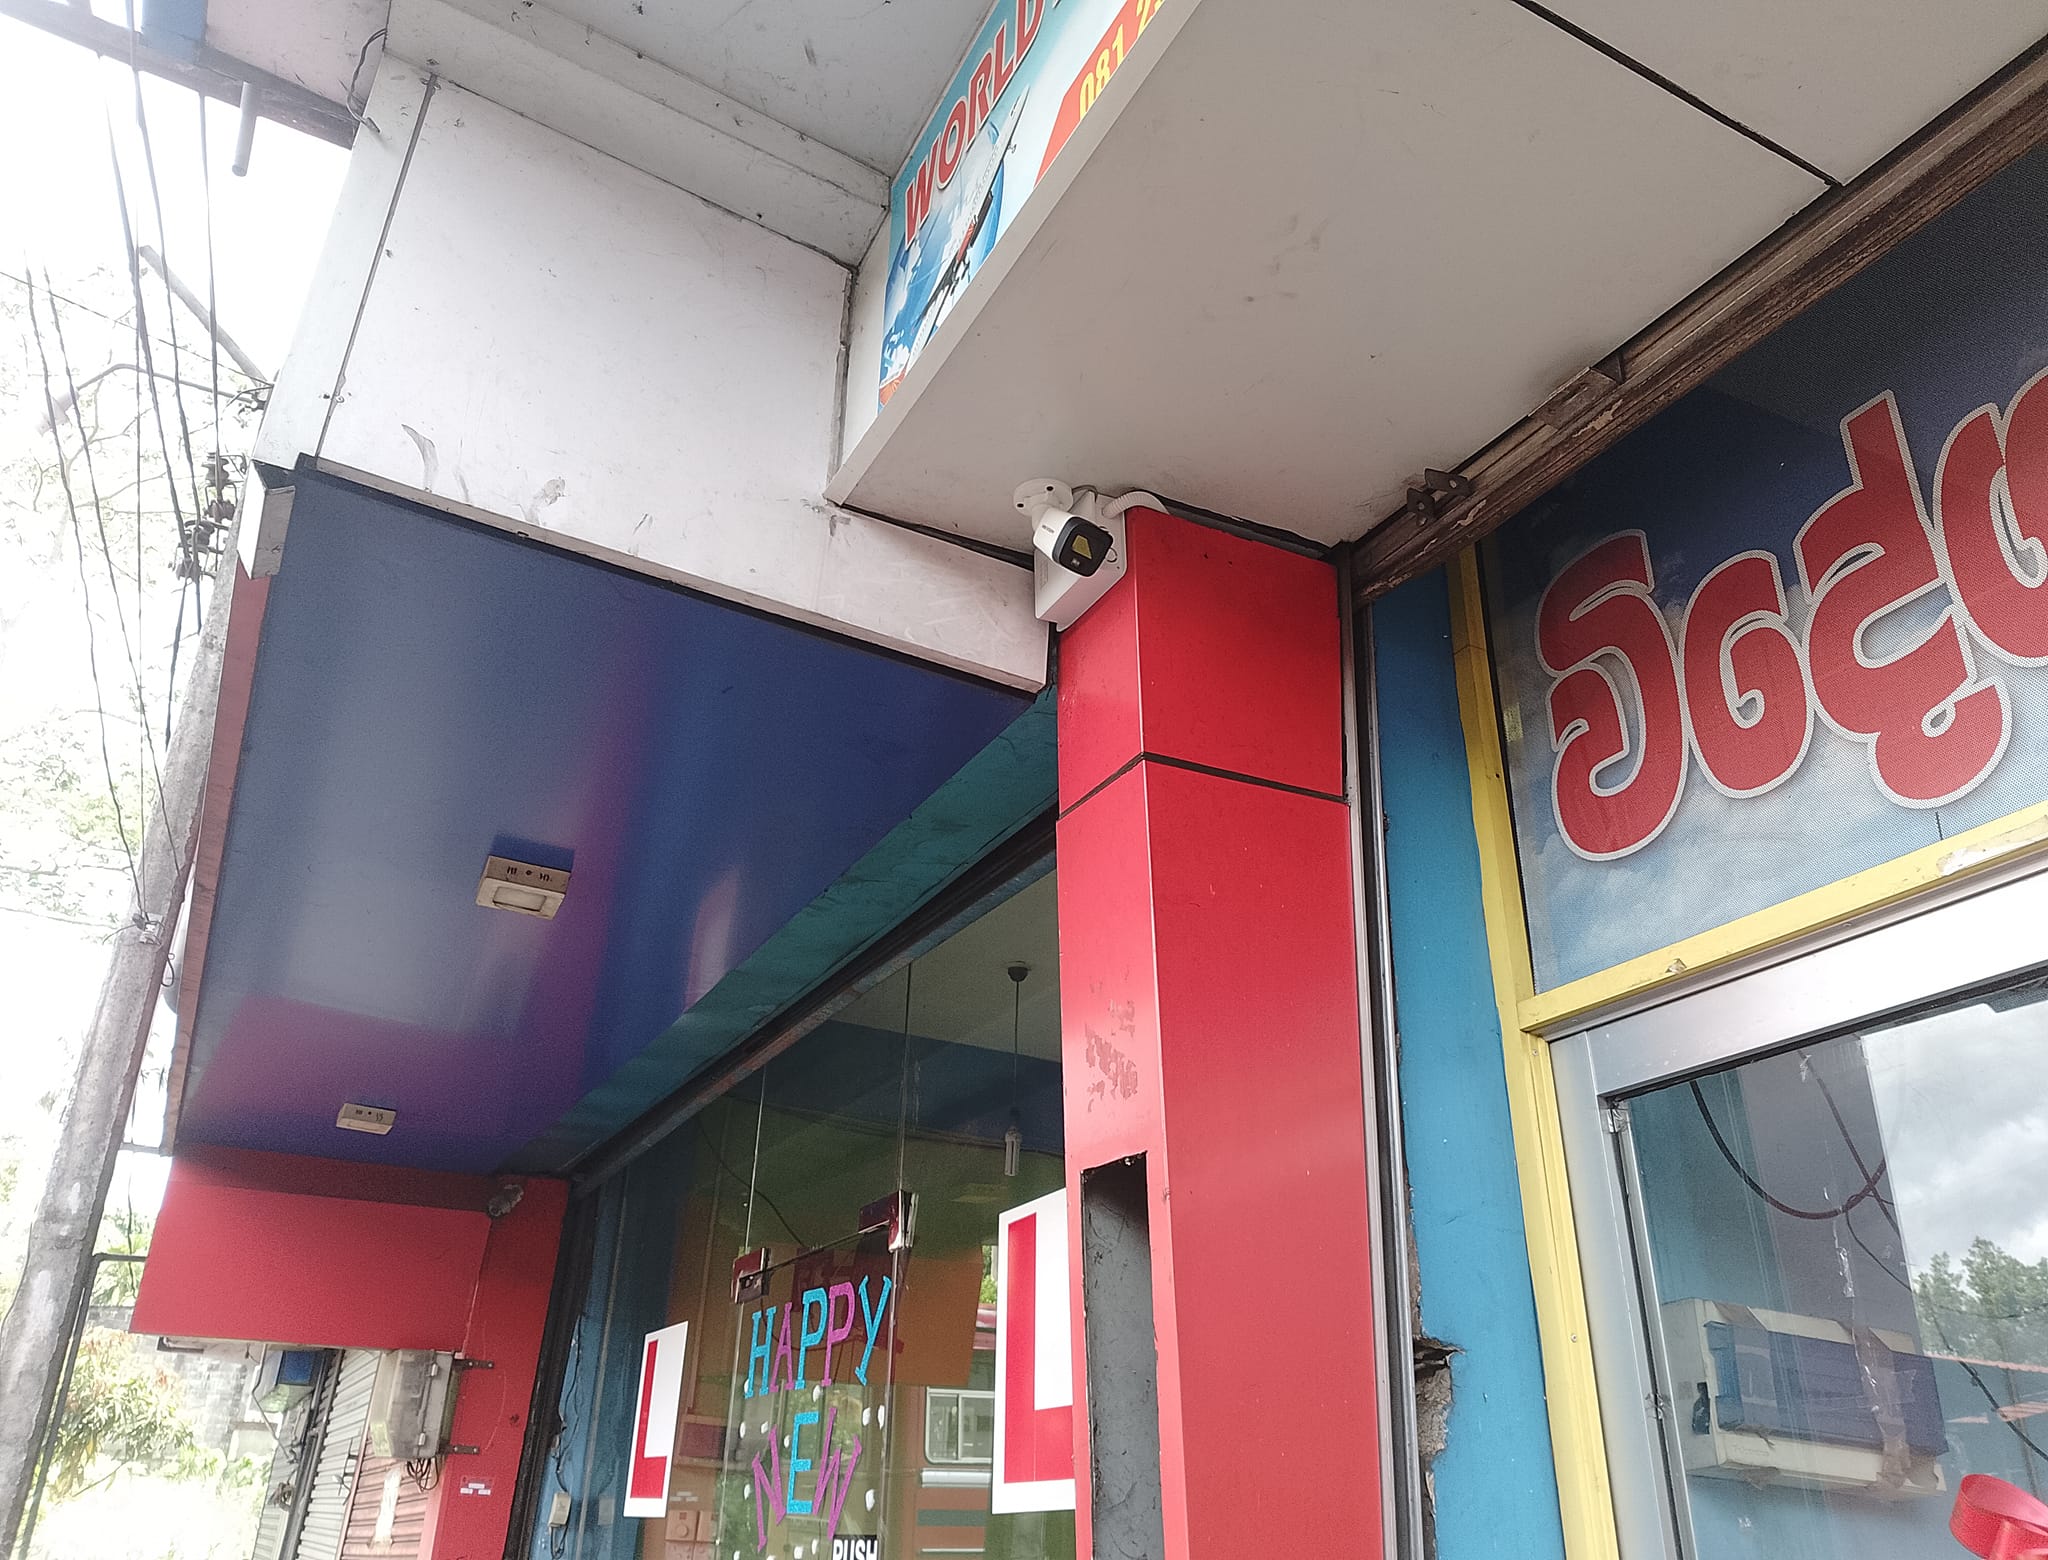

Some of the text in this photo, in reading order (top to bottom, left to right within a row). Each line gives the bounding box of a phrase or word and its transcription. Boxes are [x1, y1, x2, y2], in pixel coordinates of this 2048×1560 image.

[904, 0, 1046, 247] WORLD
[744, 1274, 893, 1399] HAPPY
[630, 1338, 668, 1499] L
[751, 1407, 862, 1552] NEW
[832, 1539, 878, 1560] PUSH
